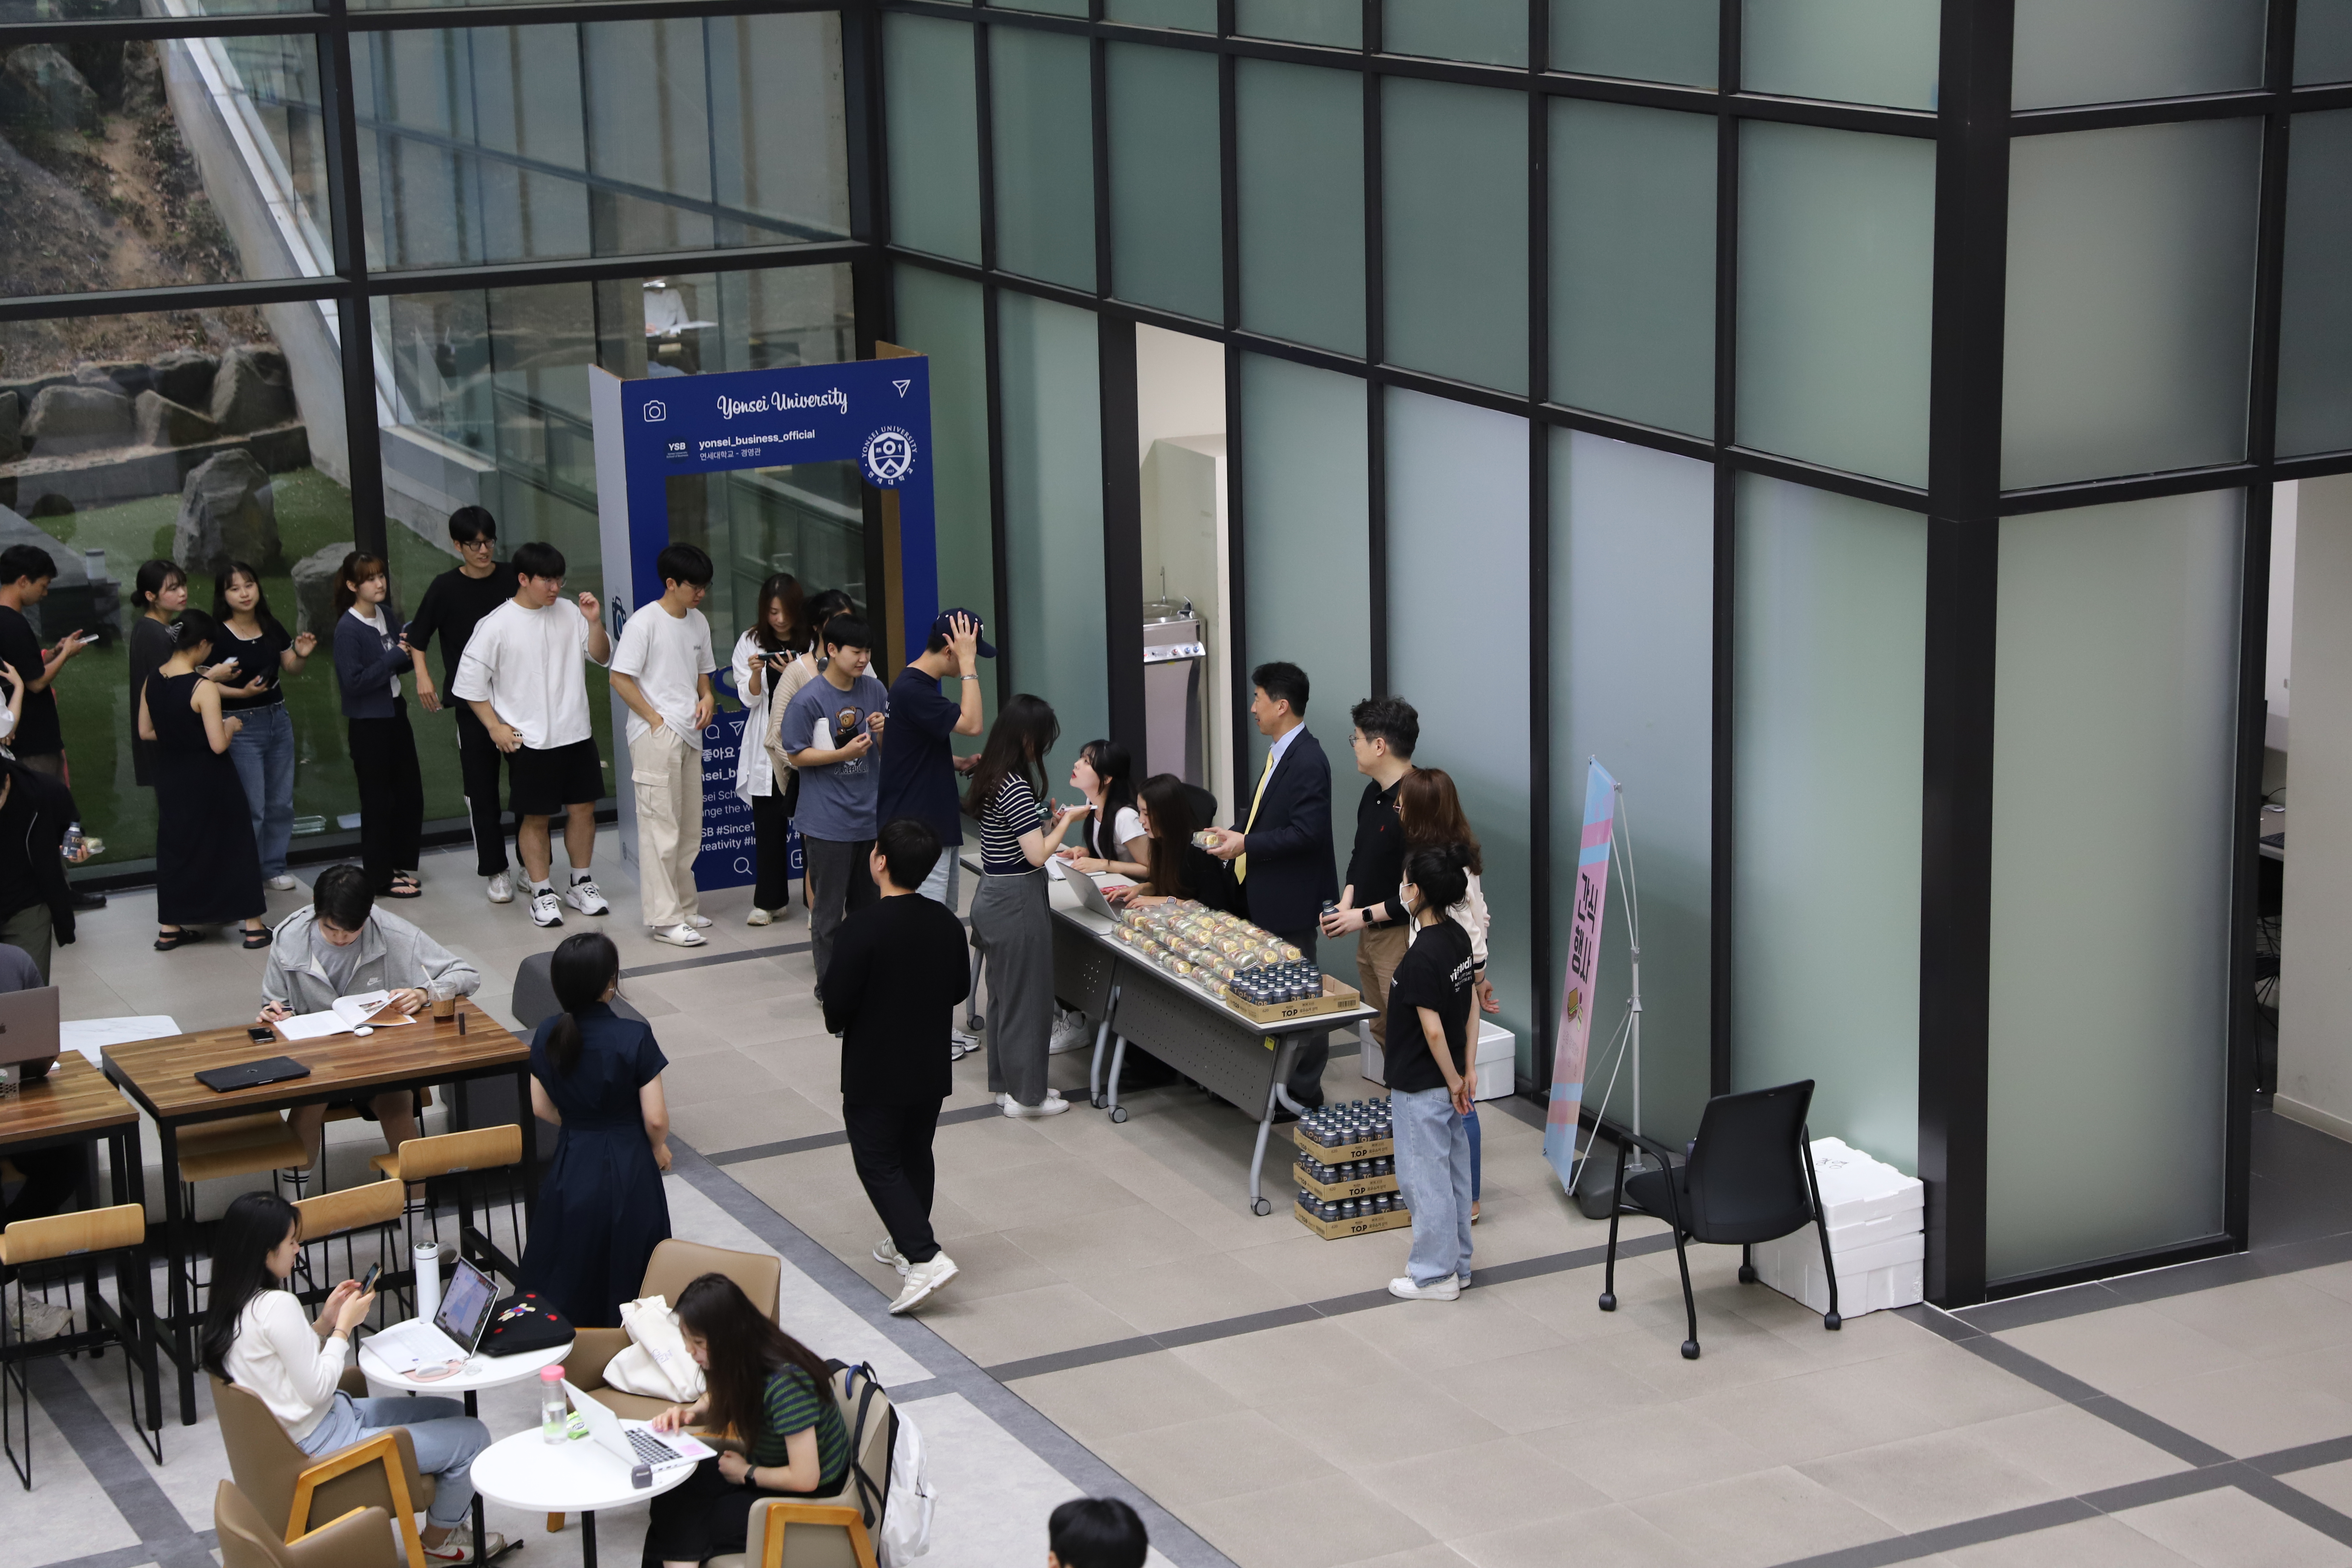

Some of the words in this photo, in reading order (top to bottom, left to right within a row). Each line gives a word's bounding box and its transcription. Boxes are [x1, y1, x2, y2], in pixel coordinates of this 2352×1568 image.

[717, 395, 769, 419] Yonsei
[771, 387, 848, 414] University
[668, 442, 686, 451] YSB
[699, 429, 815, 450] yonsei_business_official
[862, 430, 879, 458] YONSEI
[881, 425, 917, 453] UNIVERSITY
[700, 452, 734, 461] 연세대학교
[741, 447, 761, 457] 경영관
[702, 746, 735, 762] 좋아요
[725, 805, 740, 814] the
[700, 838, 741, 852] reativity
[1577, 872, 1598, 935] 간식
[1572, 924, 1591, 985] 행사
